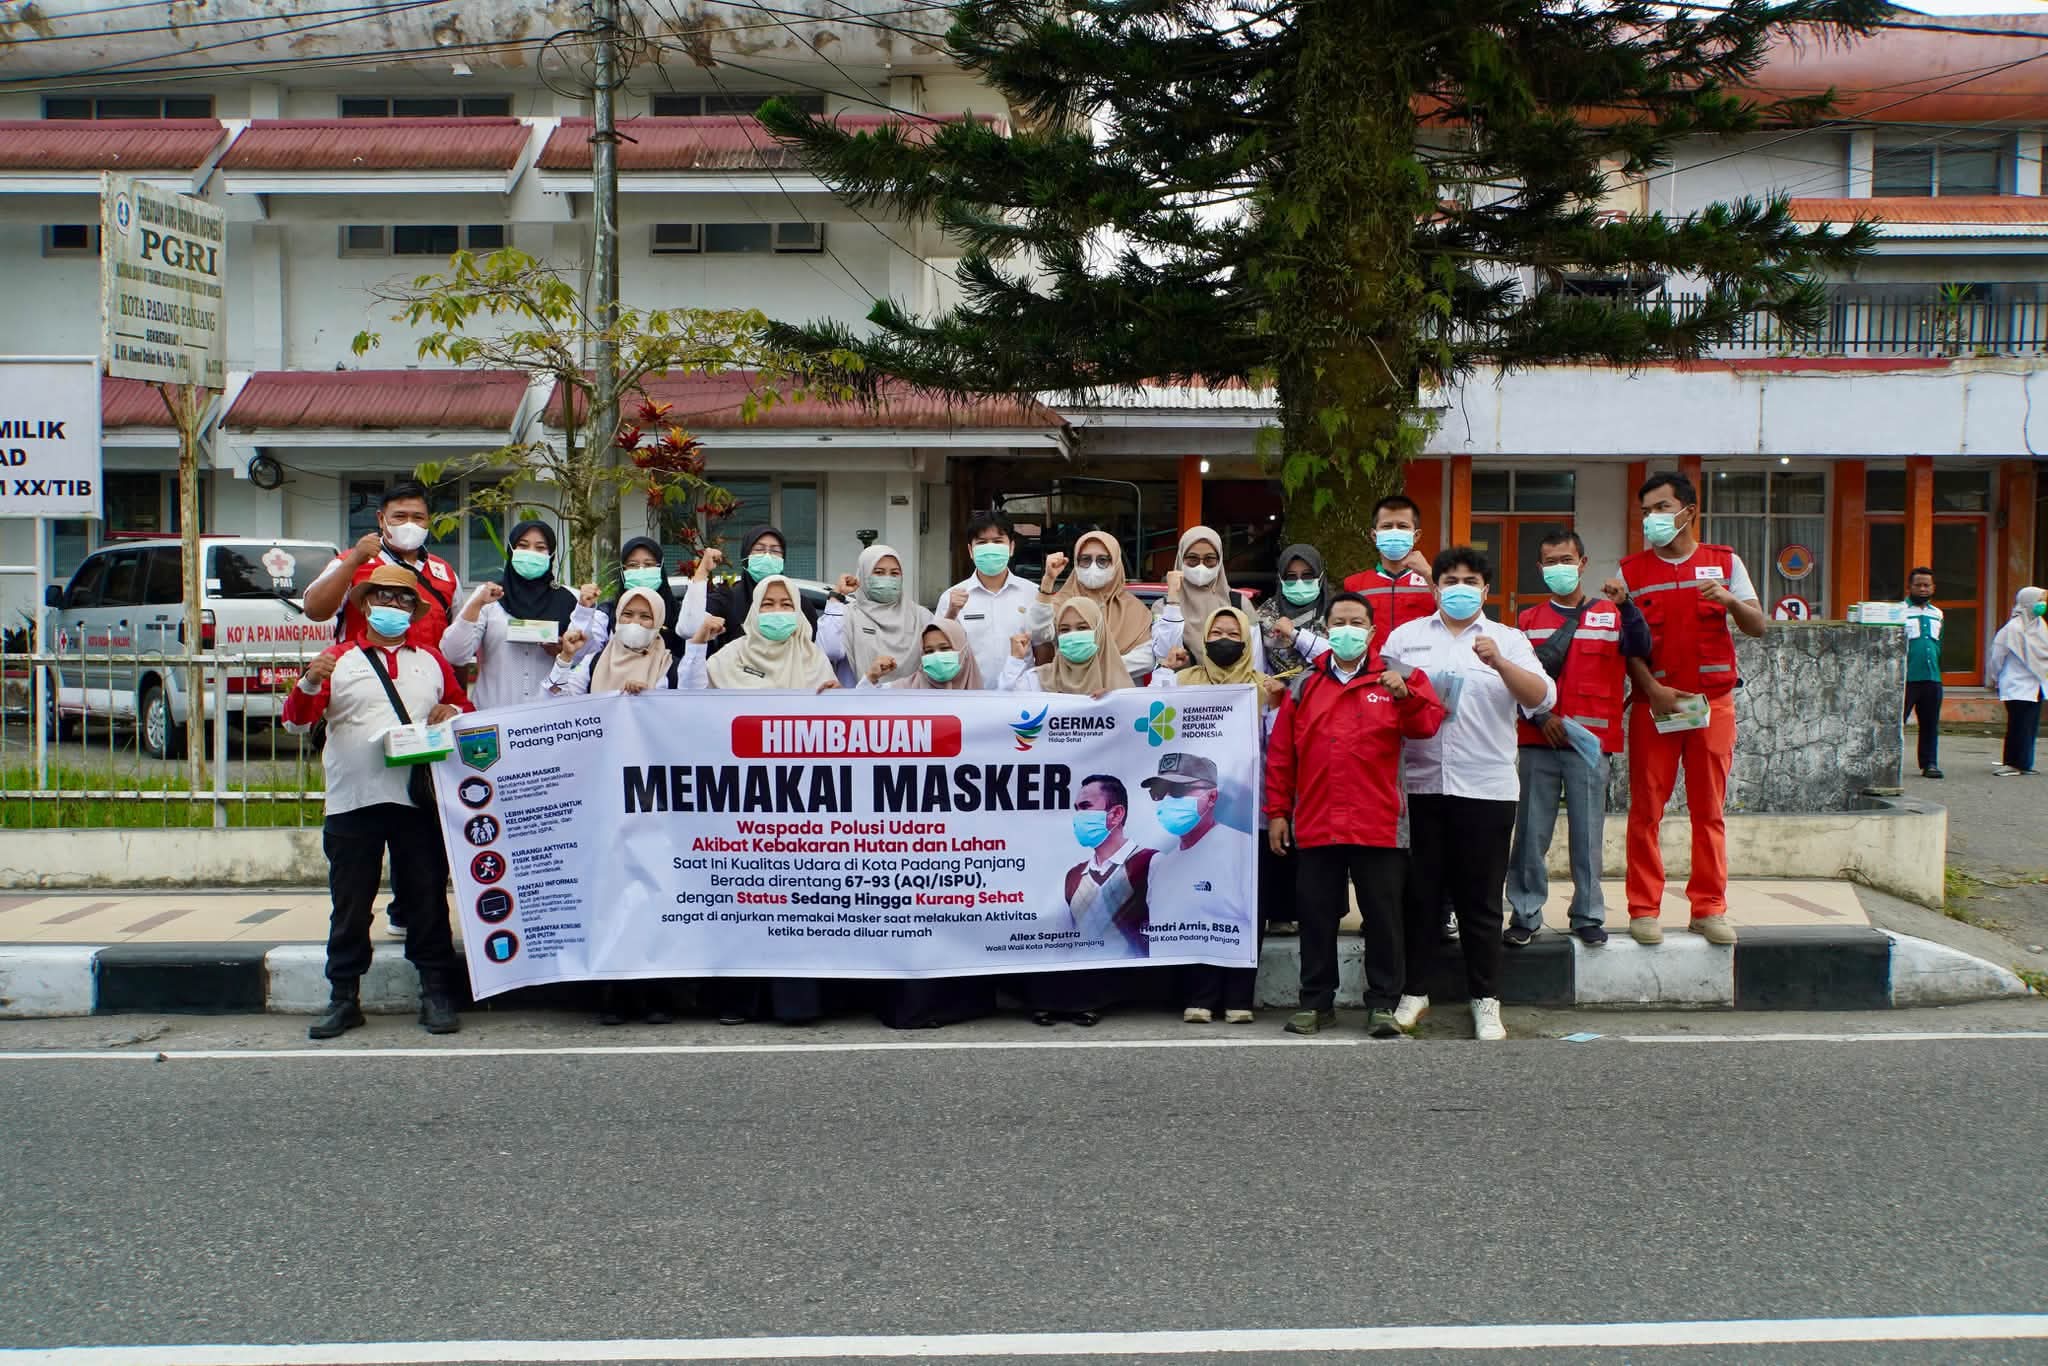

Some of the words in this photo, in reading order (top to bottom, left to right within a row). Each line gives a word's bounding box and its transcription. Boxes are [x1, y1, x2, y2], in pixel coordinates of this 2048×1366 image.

[140, 227, 217, 276] PGRI
[120, 294, 145, 319] KOTA
[146, 298, 180, 325] PADANG
[181, 305, 216, 332] PANJANG
[14, 479, 92, 496] XX/TIB
[272, 578, 293, 588] PMI
[226, 625, 255, 643] KOA
[1183, 705, 1233, 714] KEMENTERIAN
[1049, 716, 1115, 730] GERMAS
[1182, 714, 1224, 722] KESEHATAN
[508, 720, 572, 738] Pemerintah
[575, 716, 601, 727] Kota
[1182, 722, 1216, 730] REPUBLIK
[510, 735, 554, 749] Padang
[557, 727, 603, 743] Panjang
[762, 719, 933, 754] HIMBAUAN
[1181, 730, 1223, 738] INDONESIA
[497, 771, 531, 783] GUNAKAN
[532, 766, 561, 776] MASKER
[623, 765, 853, 813] MEMAKAI
[873, 763, 1071, 813] MASKER
[504, 809, 524, 818] LEBIH
[525, 803, 558, 814] WASPADA
[559, 799, 583, 809] UNTUK
[505, 814, 543, 825] KELOMPOK
[737, 820, 823, 838] Waspada
[831, 820, 884, 834] Polusi
[889, 820, 945, 834] Udara
[511, 847, 543, 858] KURANGI
[543, 842, 578, 852] AKTIVITAS
[692, 837, 749, 852] Akibat
[752, 838, 850, 852] Kebakaran
[854, 838, 908, 852] Hutan
[912, 838, 948, 852] dan
[951, 837, 1006, 851] Lahan
[673, 857, 707, 869] Saat
[711, 857, 727, 869] Ini
[731, 857, 790, 870] Kualitas
[794, 858, 841, 871] Udara
[844, 858, 858, 871] di
[862, 858, 897, 871] Kota
[901, 857, 960, 873] Padang
[964, 856, 1026, 872] Panjang
[517, 881, 544, 891] PANTAU
[711, 874, 764, 887] Berada
[768, 874, 841, 891] direntang
[845, 875, 890, 888] 67-93
[894, 871, 987, 890] (AQI/ISPU),
[518, 889, 540, 898] RESMI
[676, 891, 734, 907] dengan
[736, 891, 788, 904] Status
[791, 892, 851, 908] Sedang
[855, 892, 912, 909] Hingga
[915, 893, 975, 908] Kurang
[978, 890, 1025, 904] Sehat
[661, 911, 704, 924] sangat
[706, 911, 718, 921] di
[720, 911, 774, 924] anjurkan
[776, 912, 835, 922] memakai
[837, 913, 881, 923] Masker
[883, 913, 911, 923] saat
[914, 912, 982, 923] melakukan
[985, 910, 1037, 922] Aktivitas
[768, 926, 804, 937] ketika
[806, 926, 850, 937] berada
[853, 928, 889, 938] diluar
[891, 927, 932, 938] rumah
[1212, 923, 1240, 934] BSBA
[1009, 933, 1036, 942] Allex
[1038, 931, 1081, 942] Saputra
[1180, 934, 1209, 943] Padang
[1210, 934, 1240, 946] Panjang
[1008, 943, 1025, 951] Wali
[1044, 941, 1073, 949] Padang
[1074, 939, 1105, 947] Panjang
